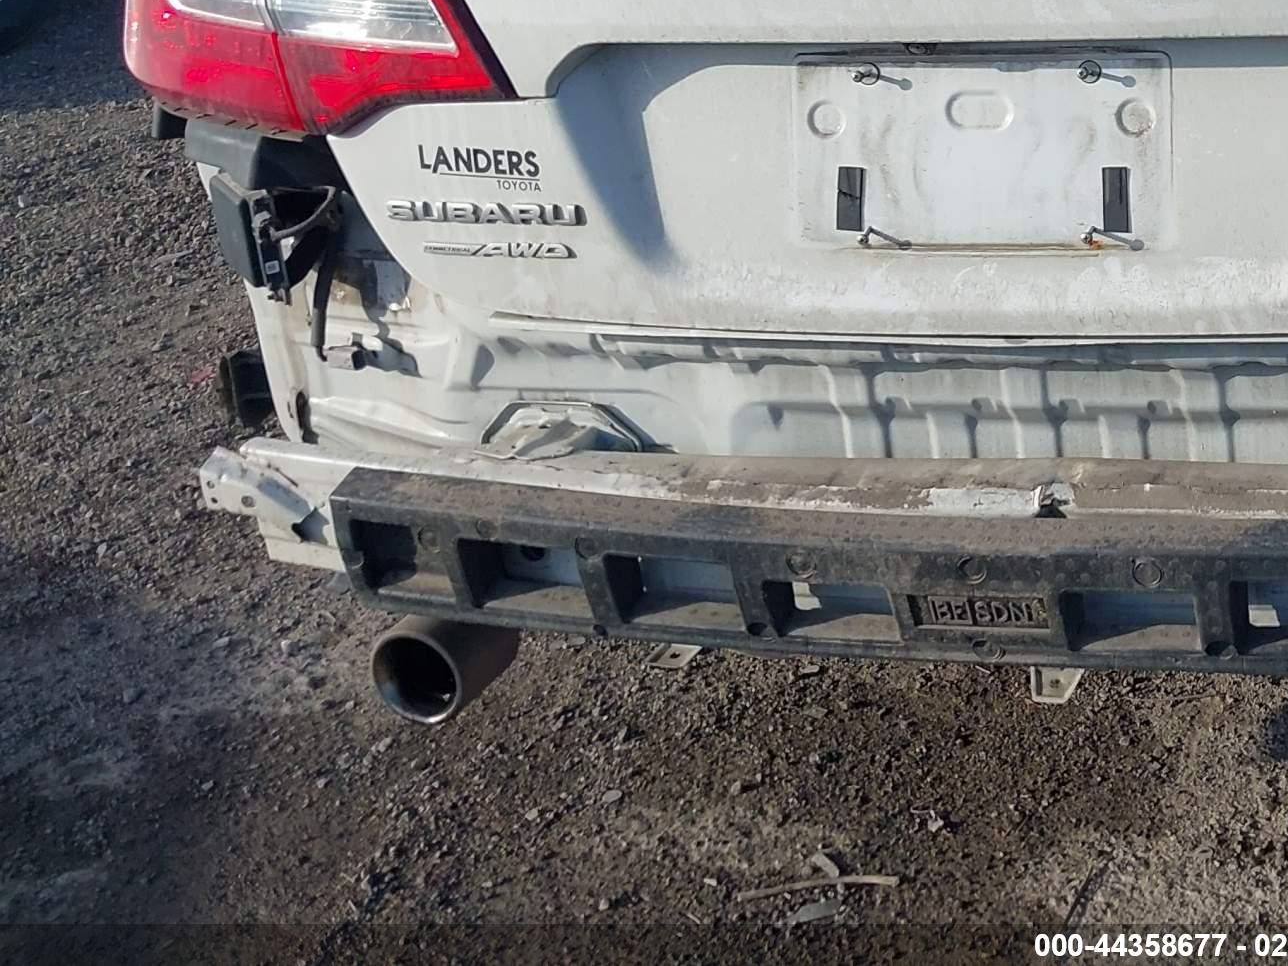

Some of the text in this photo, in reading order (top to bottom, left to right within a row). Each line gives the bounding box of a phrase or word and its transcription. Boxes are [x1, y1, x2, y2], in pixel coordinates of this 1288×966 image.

[418, 144, 540, 178] LANDERS
[496, 179, 541, 192] TOYOTA
[386, 199, 587, 227] SUBARU
[474, 241, 577, 259] AWD
